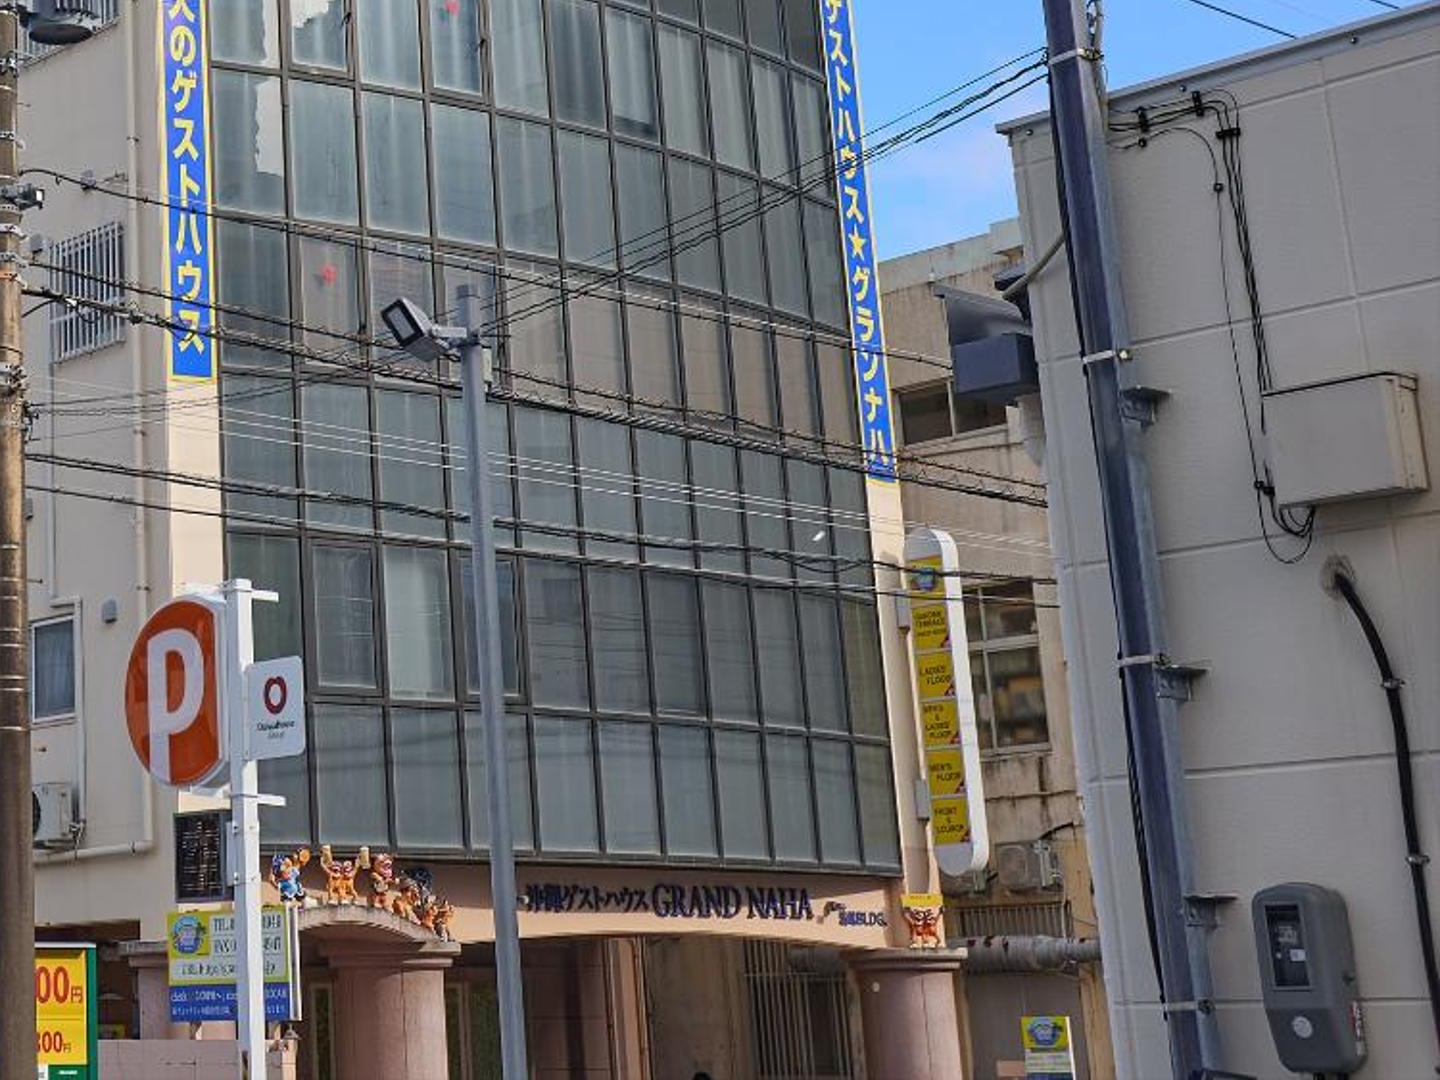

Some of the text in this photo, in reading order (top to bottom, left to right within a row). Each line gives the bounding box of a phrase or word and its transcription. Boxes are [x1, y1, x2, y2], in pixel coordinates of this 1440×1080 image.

[147, 627, 205, 784] P
[651, 883, 742, 919] GRAND
[746, 886, 814, 921] NAHA
